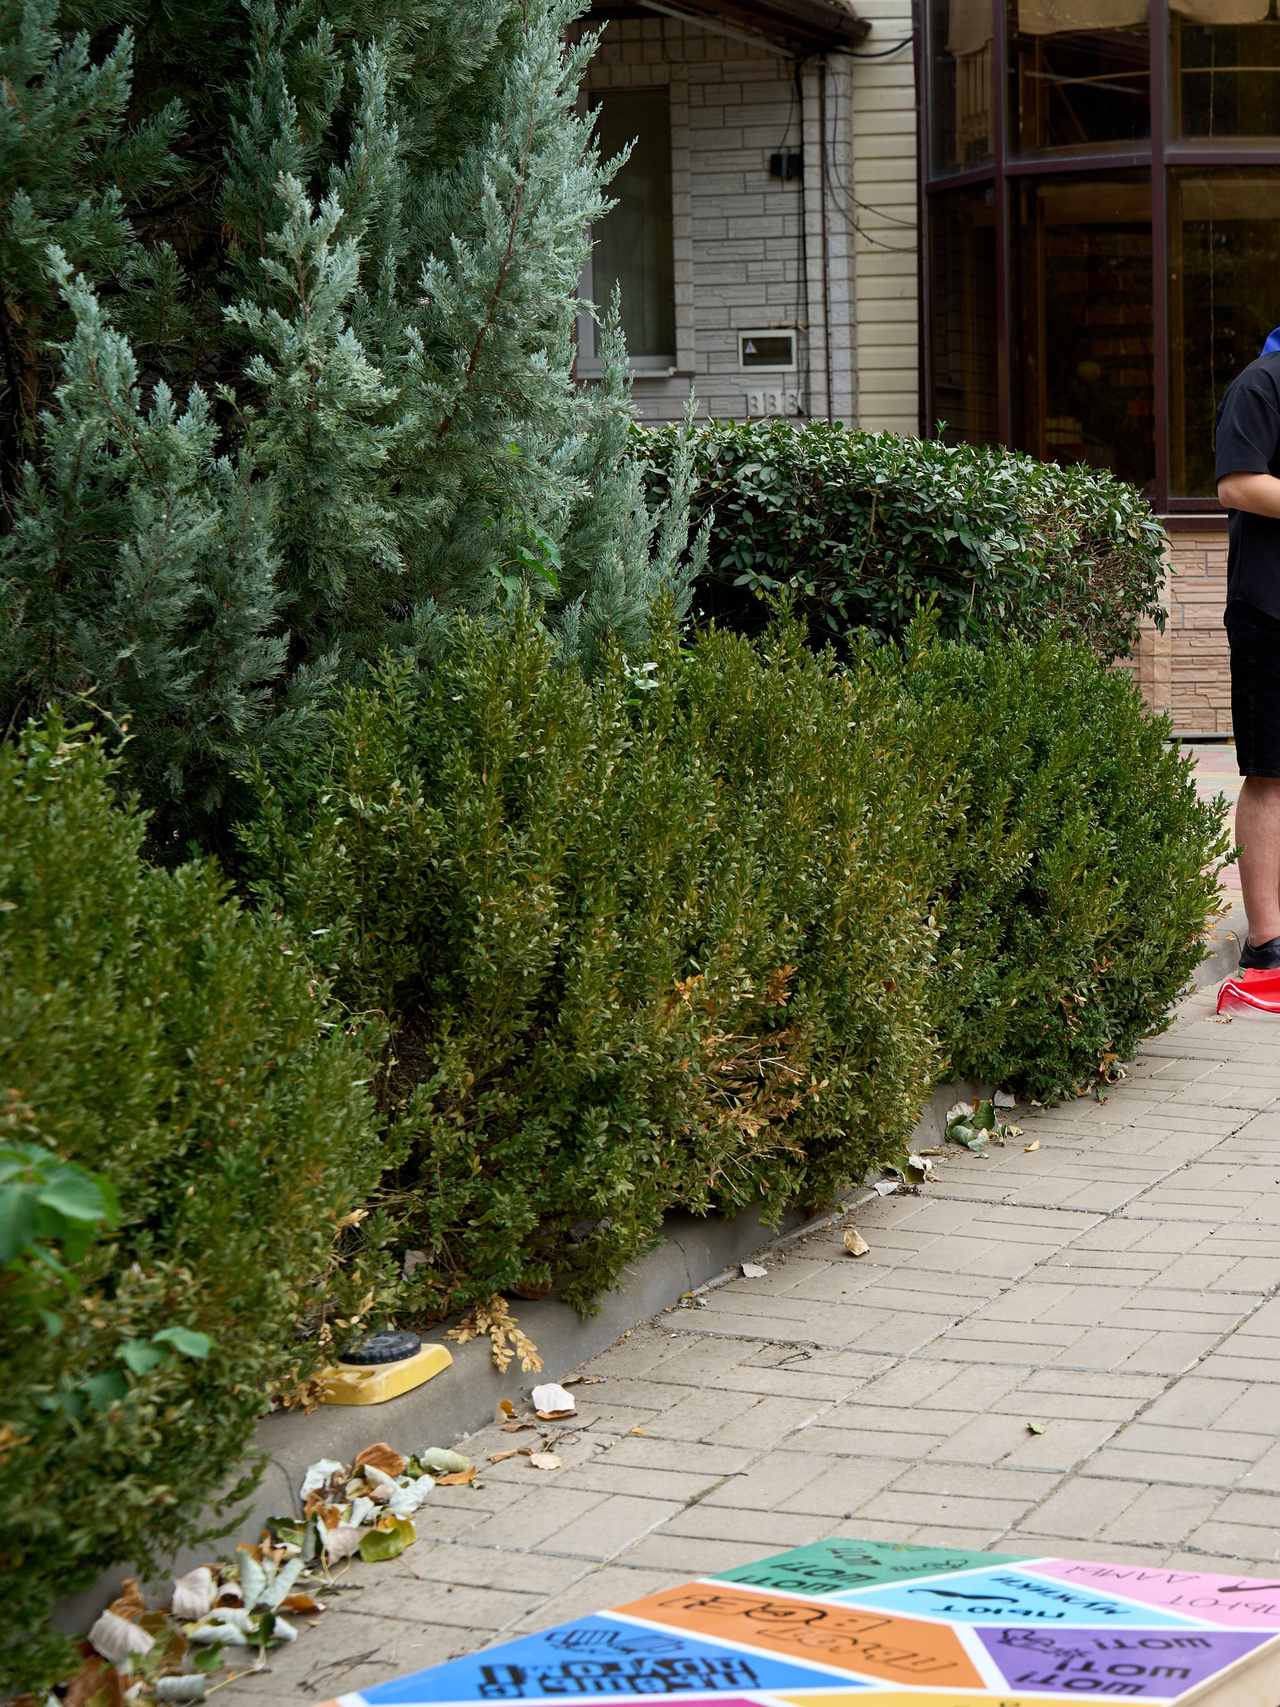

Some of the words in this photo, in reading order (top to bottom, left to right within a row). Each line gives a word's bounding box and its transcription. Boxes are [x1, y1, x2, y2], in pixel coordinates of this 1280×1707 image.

[769, 1562, 878, 1584] ШОТ!
[1064, 1566, 1201, 1584] ДАМЫ
[731, 1575, 843, 1593] ШОТ!
[1090, 1637, 1212, 1651] ШОТ!
[1053, 1659, 1192, 1680] ШОТ!
[1014, 1670, 1146, 1696] ШОТ!
